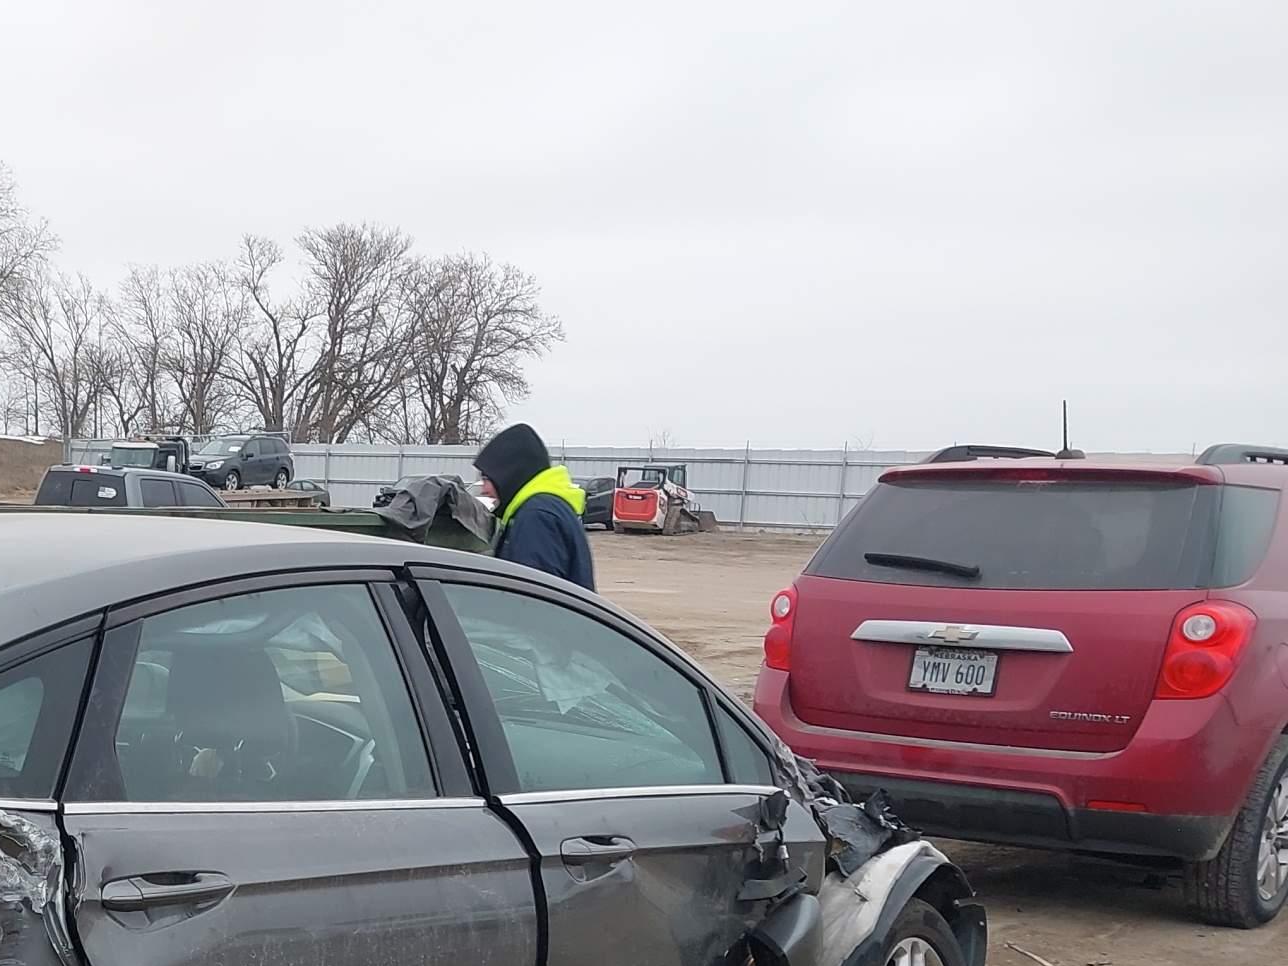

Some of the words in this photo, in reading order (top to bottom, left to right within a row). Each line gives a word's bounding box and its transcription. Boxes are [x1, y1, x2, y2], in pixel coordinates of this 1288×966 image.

[922, 660, 951, 684] YMV
[954, 663, 986, 686] 600
[1049, 710, 1112, 723] EQUINOX
[1113, 715, 1130, 724] LT
